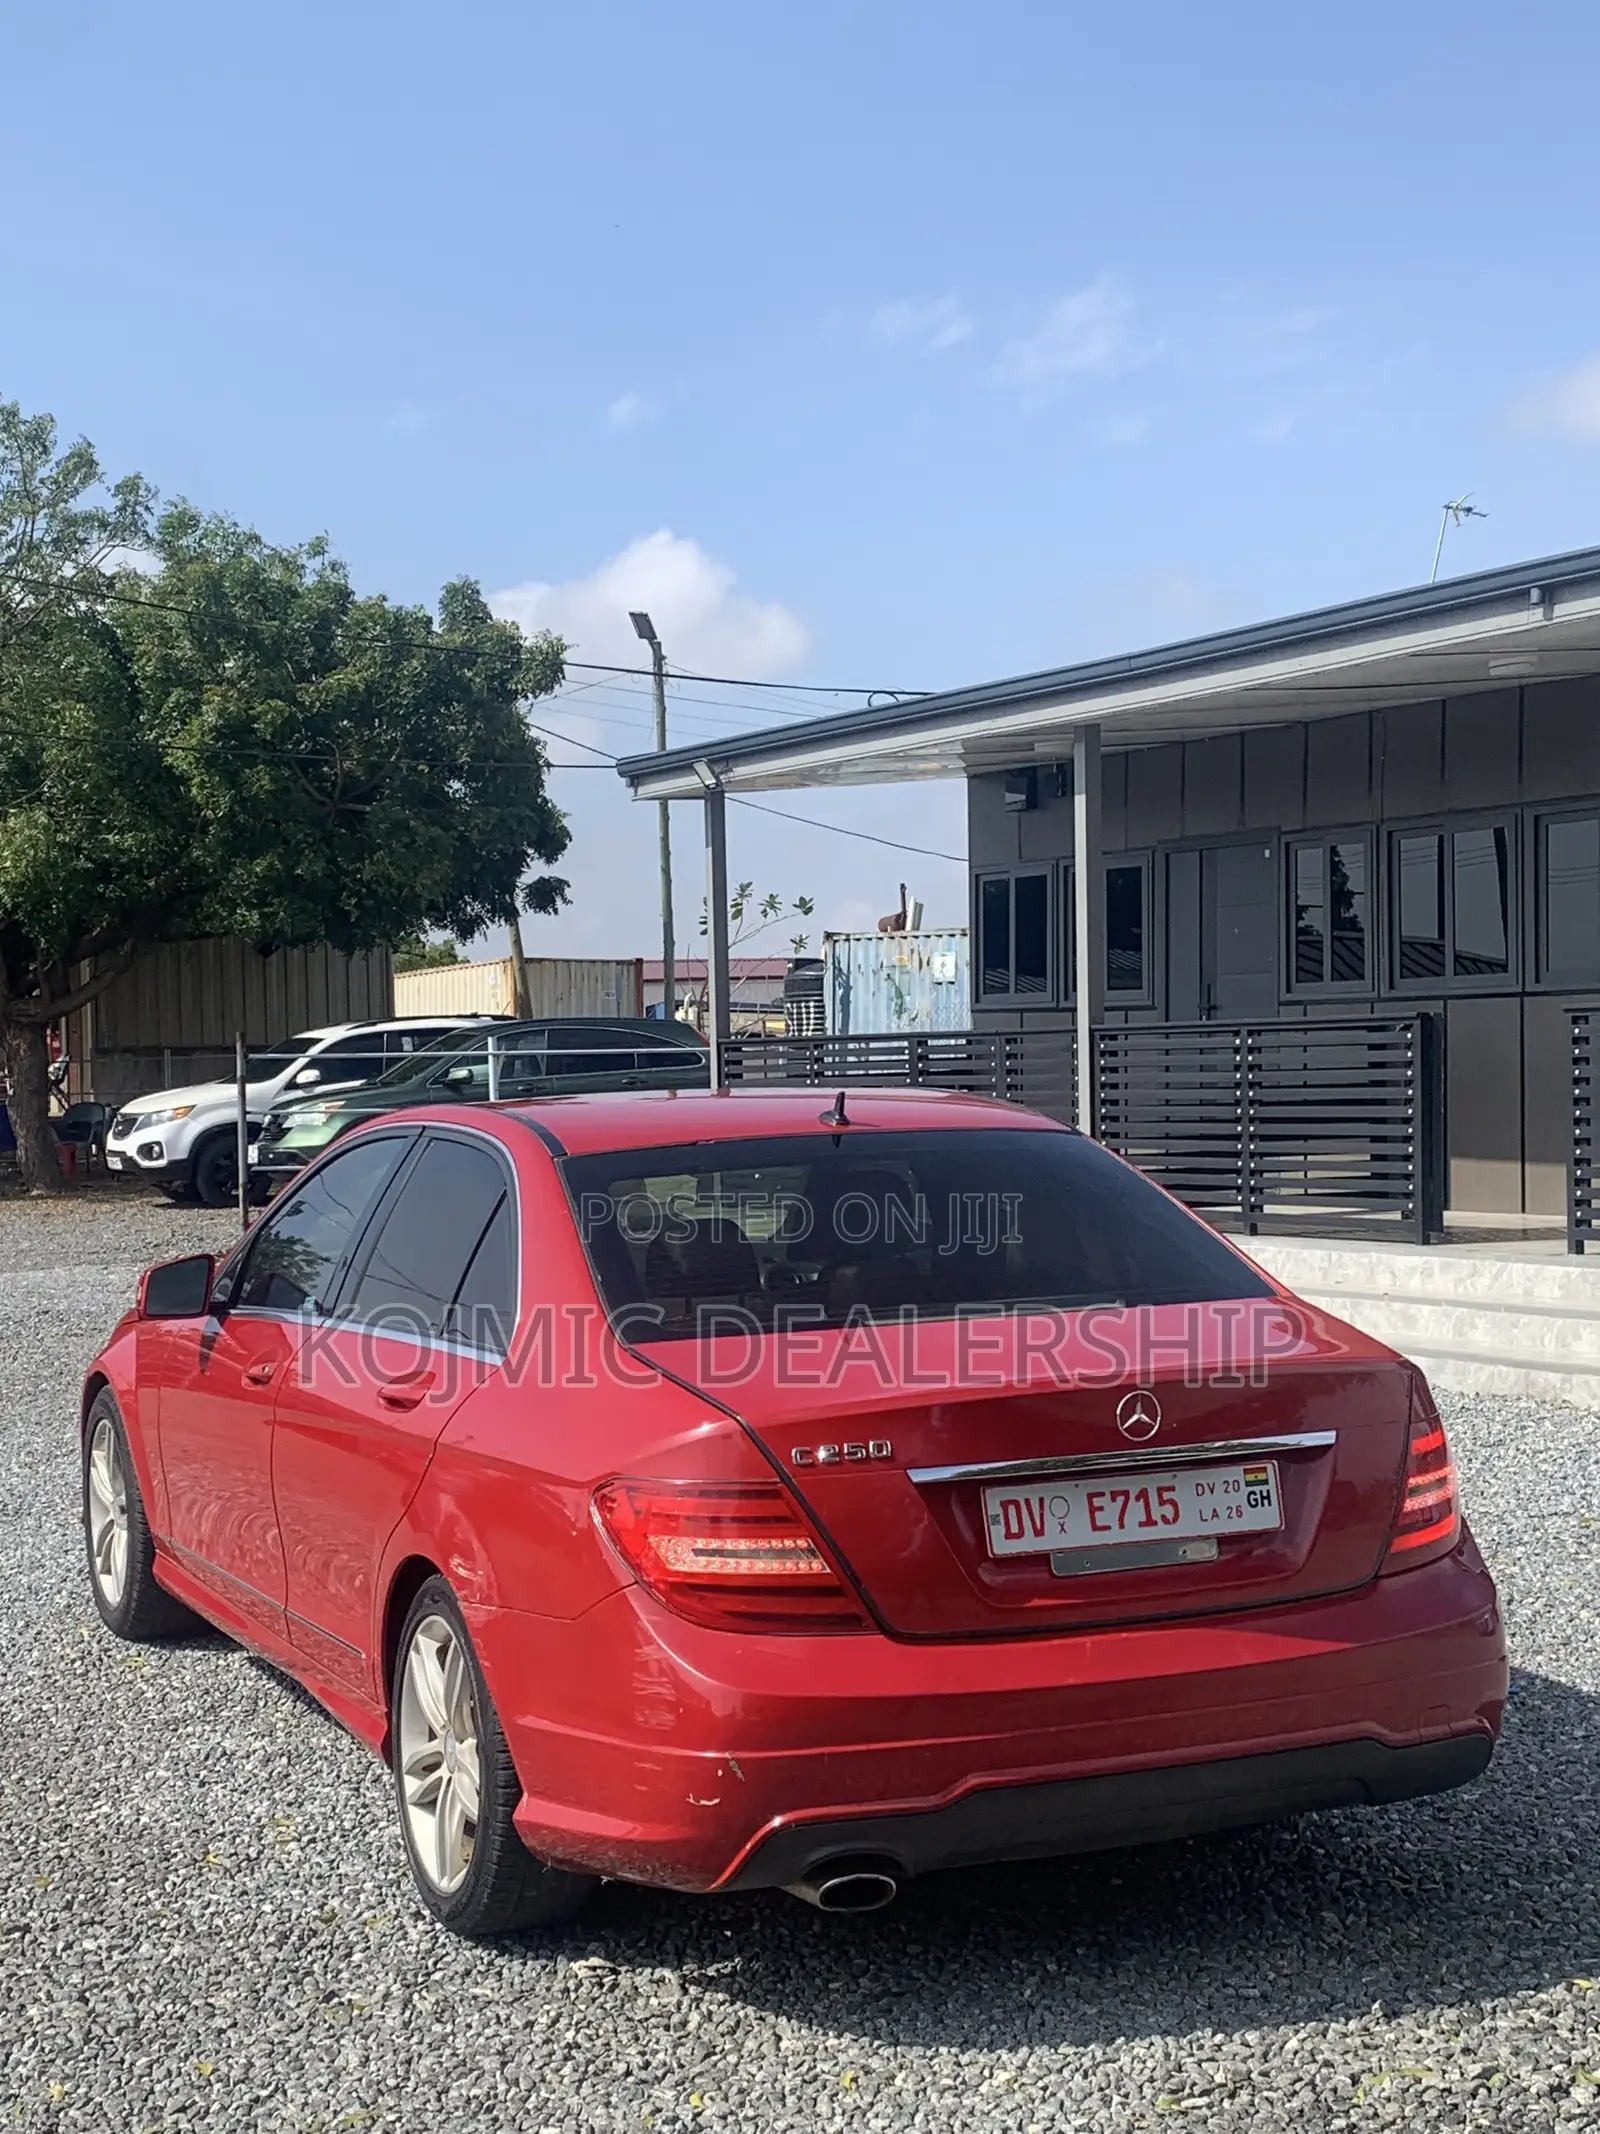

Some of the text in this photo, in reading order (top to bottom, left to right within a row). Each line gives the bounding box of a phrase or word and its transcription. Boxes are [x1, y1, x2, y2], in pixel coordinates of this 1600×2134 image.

[1195, 1479, 1241, 1497] DV 20
[1246, 1488, 1273, 1509] GH
[999, 1485, 1181, 1540] DV E715
[1198, 1504, 1244, 1523] LA 26
